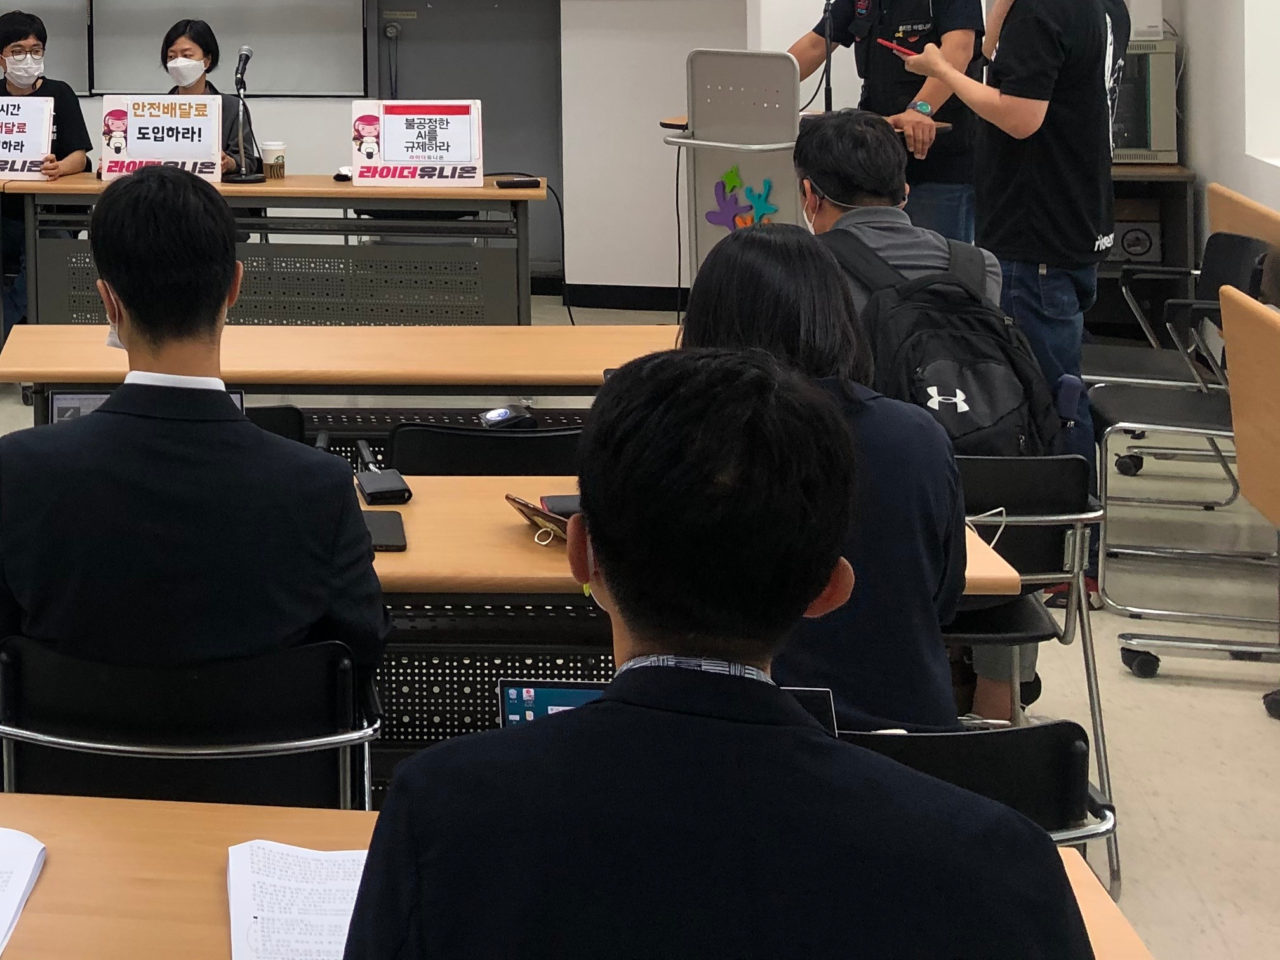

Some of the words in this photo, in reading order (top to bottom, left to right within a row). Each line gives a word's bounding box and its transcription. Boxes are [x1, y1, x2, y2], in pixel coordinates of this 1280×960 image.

[132, 101, 209, 119] 안전배달료
[404, 117, 450, 130] 불공정한
[136, 126, 202, 143] 도입하라!
[415, 130, 438, 142] AI를
[404, 141, 450, 153] 규제하라
[358, 165, 477, 179] 라이더유니온
